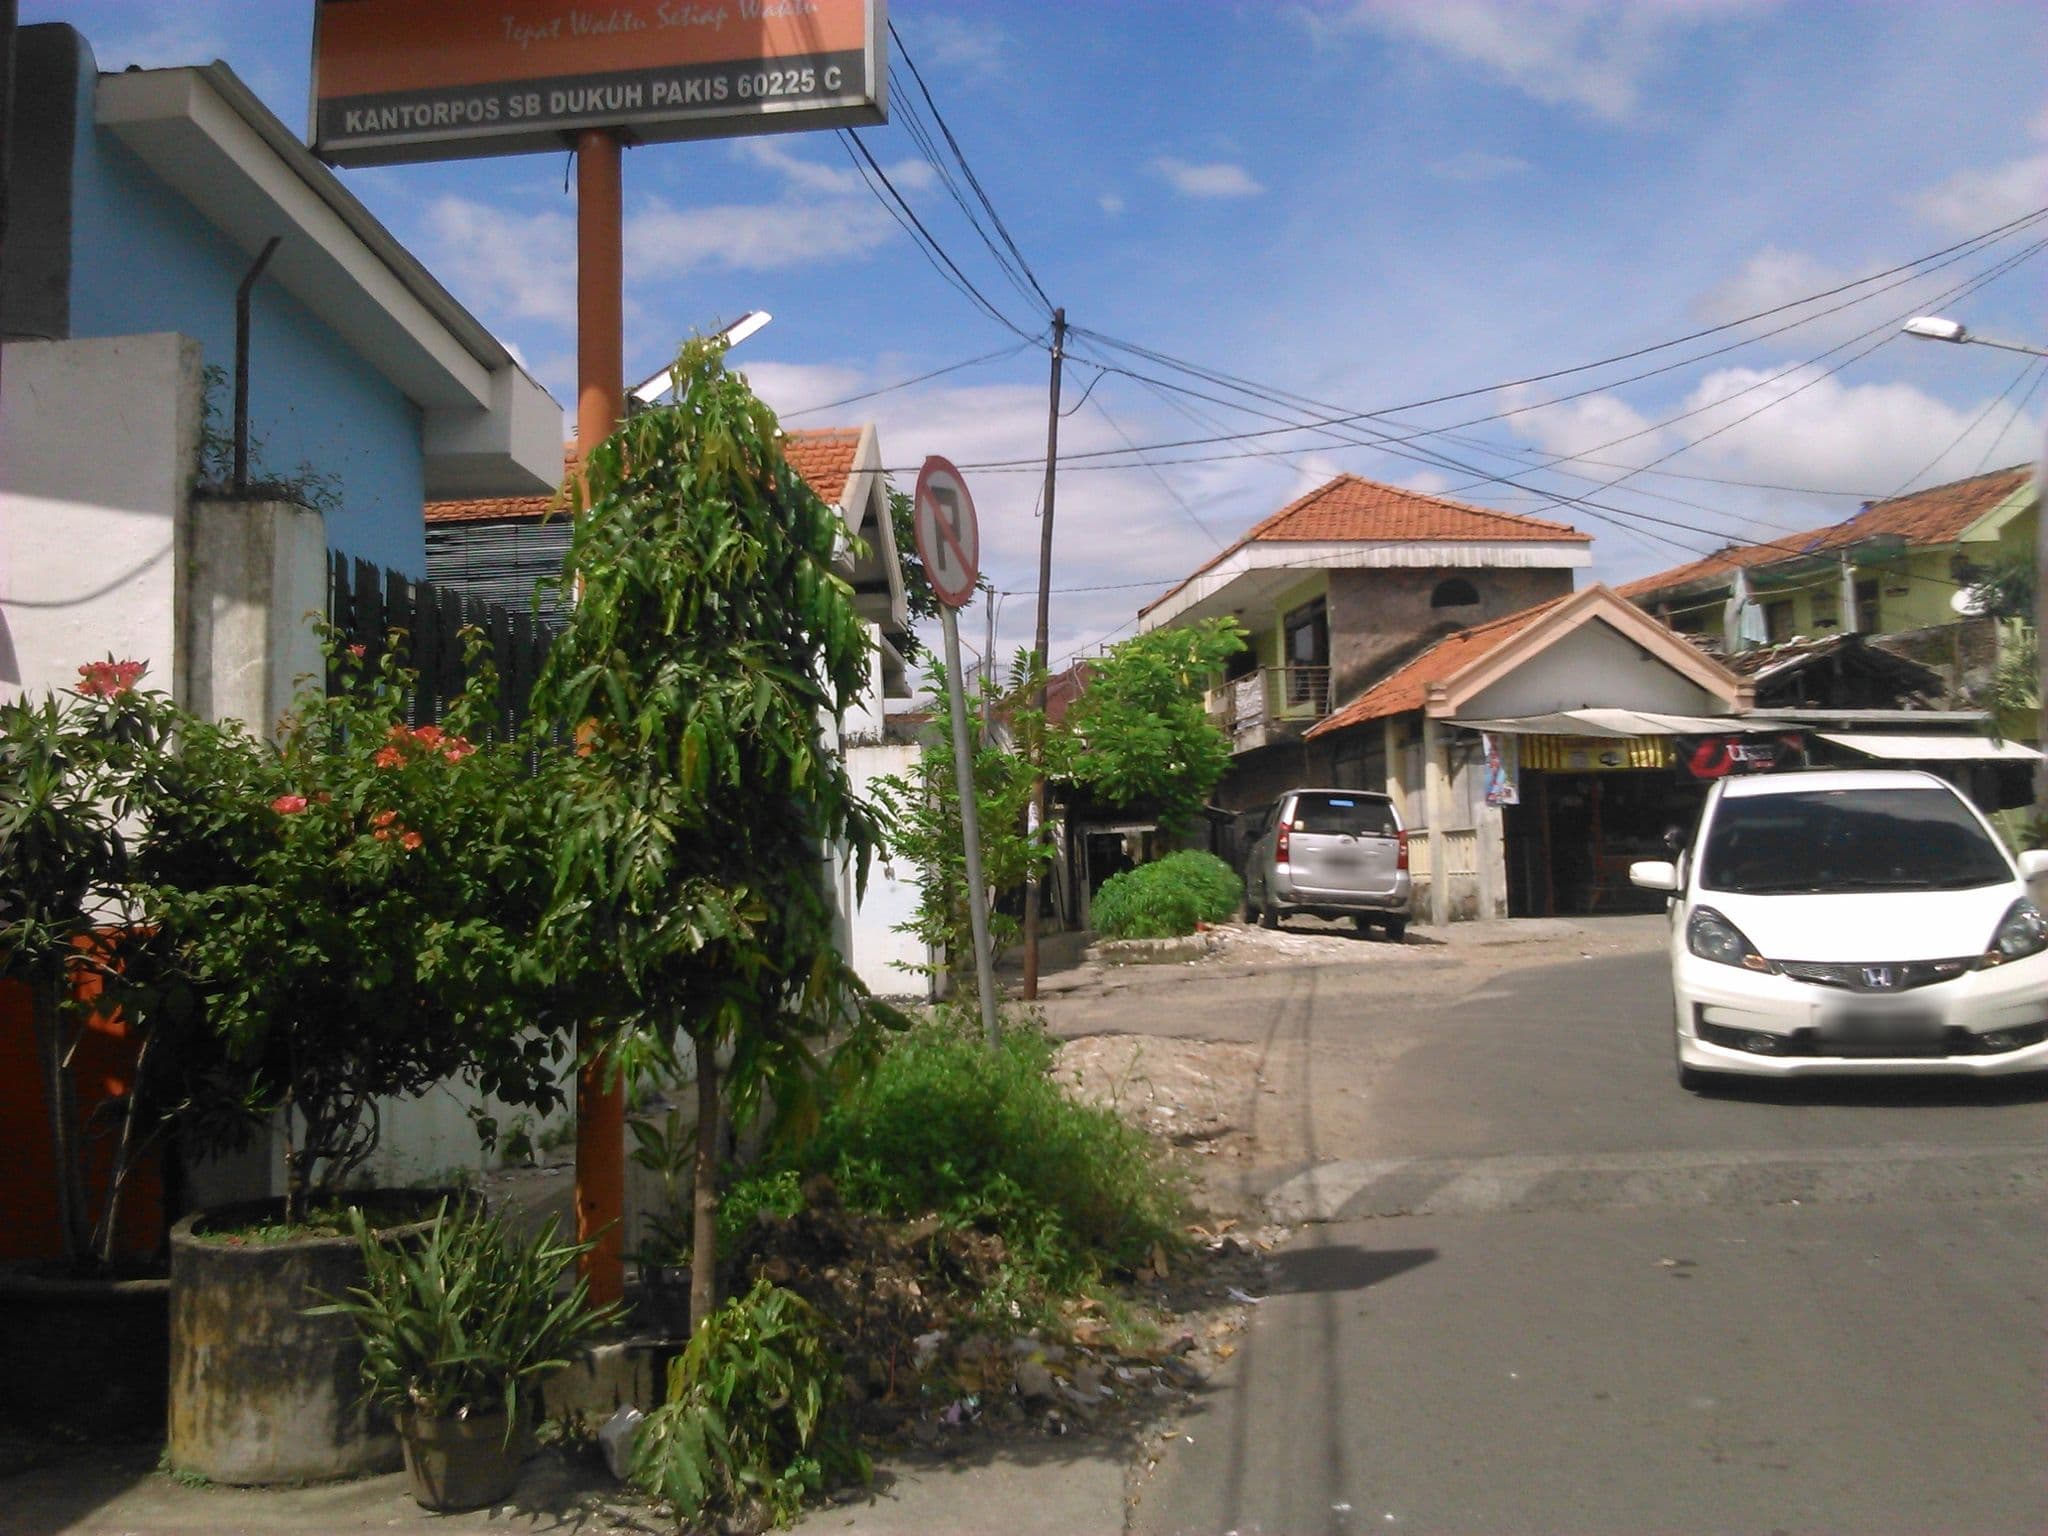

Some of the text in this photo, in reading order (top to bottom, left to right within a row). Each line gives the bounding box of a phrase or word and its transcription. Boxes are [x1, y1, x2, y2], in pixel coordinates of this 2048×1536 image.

[502, 0, 819, 50] Tepat Waktu Setiap Waktu
[344, 66, 842, 133] KANTORPOS SB DUKUH PAKIS 60225 C
